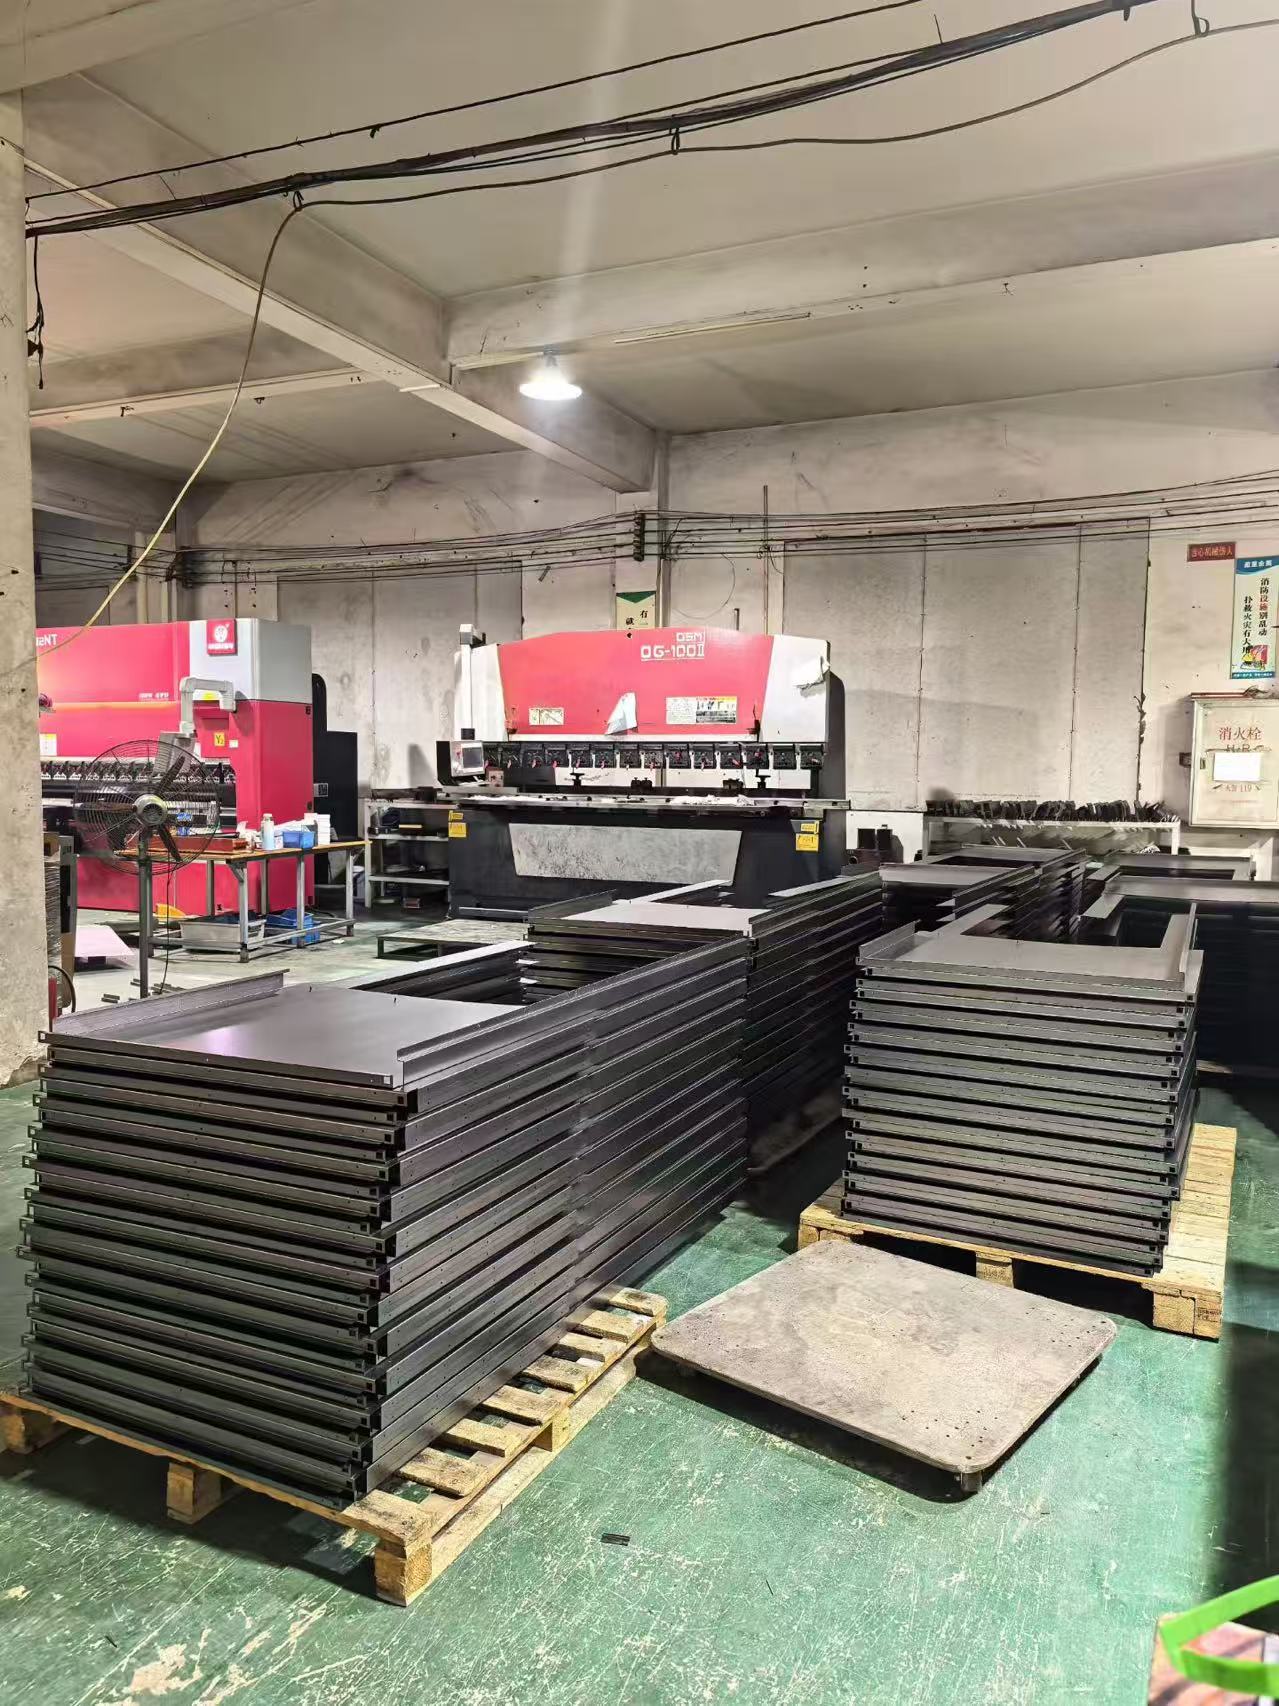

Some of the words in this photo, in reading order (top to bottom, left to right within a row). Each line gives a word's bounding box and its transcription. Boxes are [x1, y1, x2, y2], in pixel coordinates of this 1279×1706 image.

[1258, 577, 1270, 636] 消防设施别乱动
[1218, 726, 1262, 741] 消火栓
